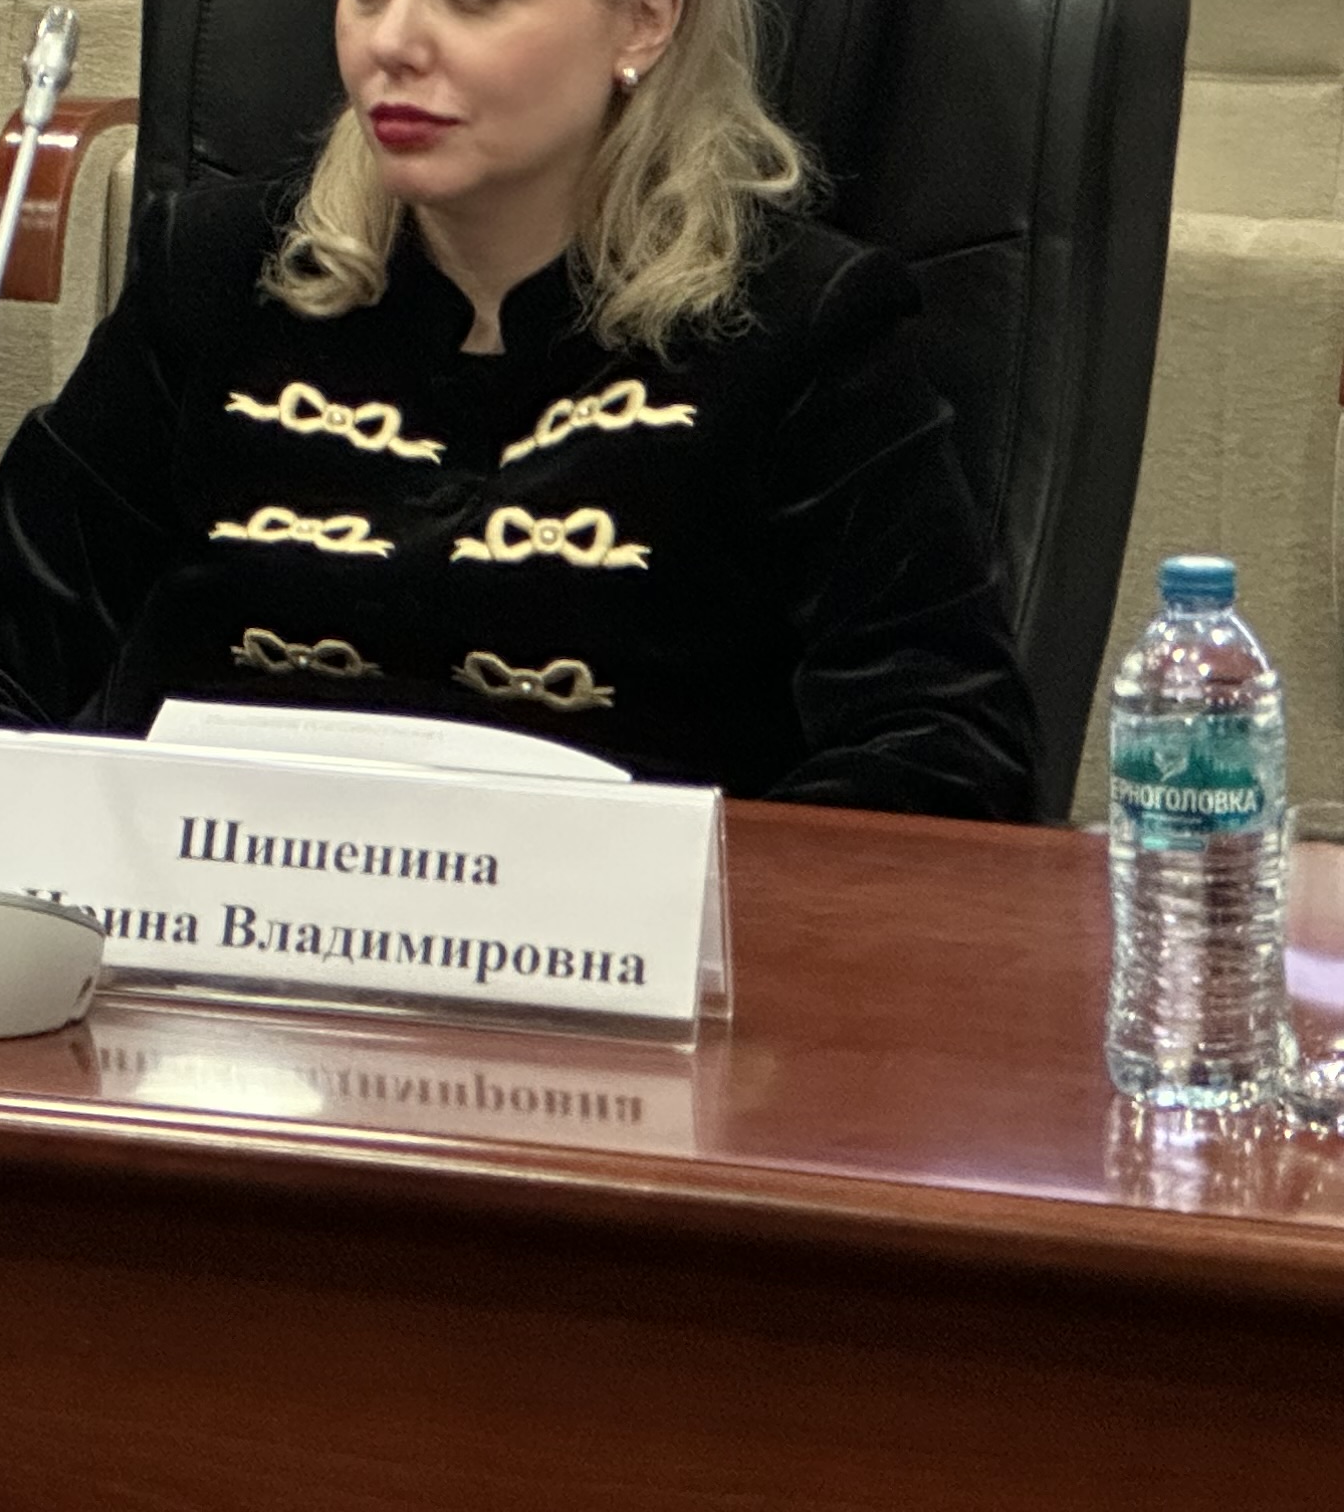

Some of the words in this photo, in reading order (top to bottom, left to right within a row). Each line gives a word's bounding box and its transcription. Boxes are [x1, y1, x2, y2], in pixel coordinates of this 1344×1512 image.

[177, 816, 499, 886] Шишенина
[26, 888, 199, 944] ина
[219, 903, 647, 986] Владимировна
